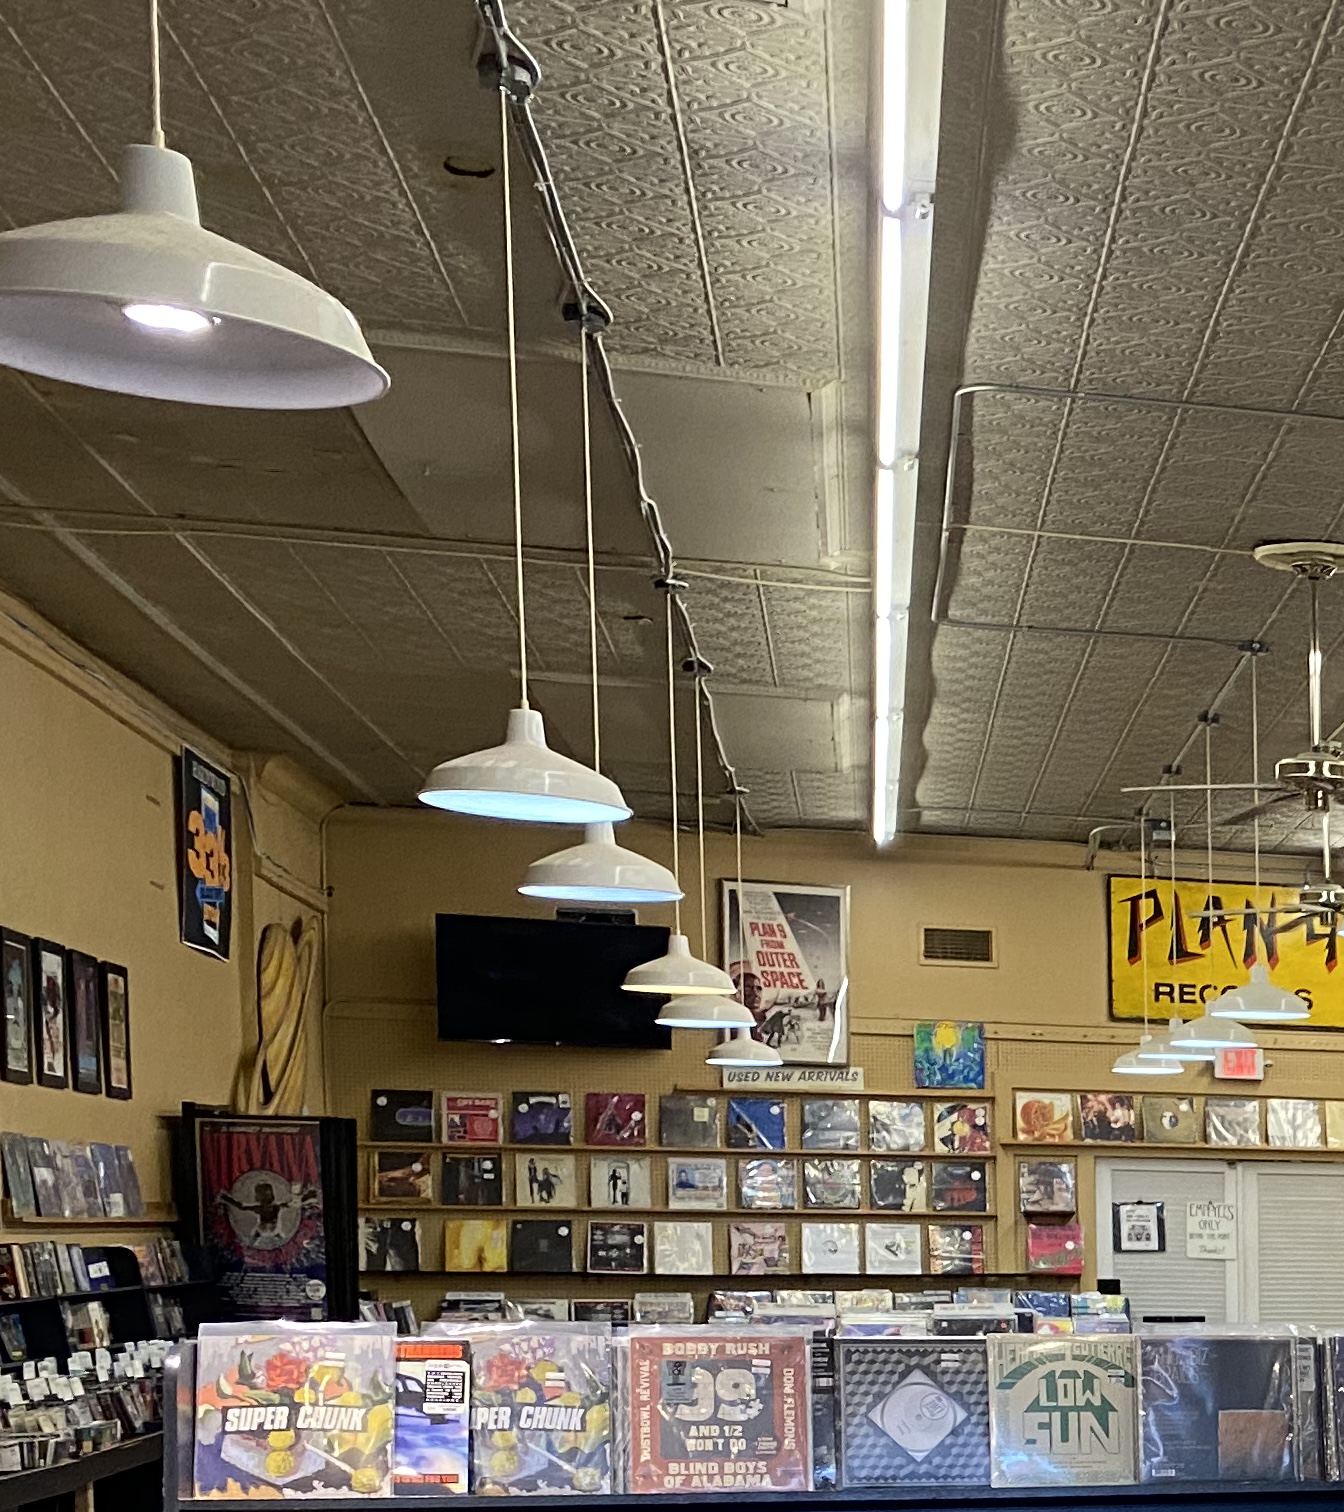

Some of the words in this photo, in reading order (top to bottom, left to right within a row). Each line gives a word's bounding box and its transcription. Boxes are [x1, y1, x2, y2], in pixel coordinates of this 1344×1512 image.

[749, 921, 776, 938] PLAN
[777, 922, 787, 939] 9
[1118, 888, 1280, 970] PLAN
[761, 940, 785, 950] FROM
[756, 950, 800, 968] OUTER
[760, 970, 808, 990] SPACE
[1154, 982, 1313, 1010] RECS
[727, 1071, 760, 1083] USED
[764, 1071, 793, 1083] NEW
[798, 1071, 859, 1083] ARRIVALS
[1198, 1220, 1221, 1230] ONLY
[662, 1342, 719, 1357] BOBBY
[724, 1342, 770, 1356] RUSH
[639, 1359, 651, 1402] REVIVAL
[1038, 1377, 1102, 1407] LOW
[225, 1407, 289, 1431] SUPER
[297, 1407, 366, 1431] CHUNK
[472, 1406, 511, 1431] PER
[519, 1406, 585, 1431] CHUNK
[639, 1405, 652, 1463] DUSTBOWL
[688, 1425, 720, 1438] AND
[1022, 1411, 1121, 1455] SUN
[728, 1438, 747, 1452] DO
[667, 1461, 718, 1475] BLIND
[723, 1461, 768, 1475] BOYS
[663, 1475, 681, 1489] OF
[684, 1474, 773, 1489] ALABAMA
